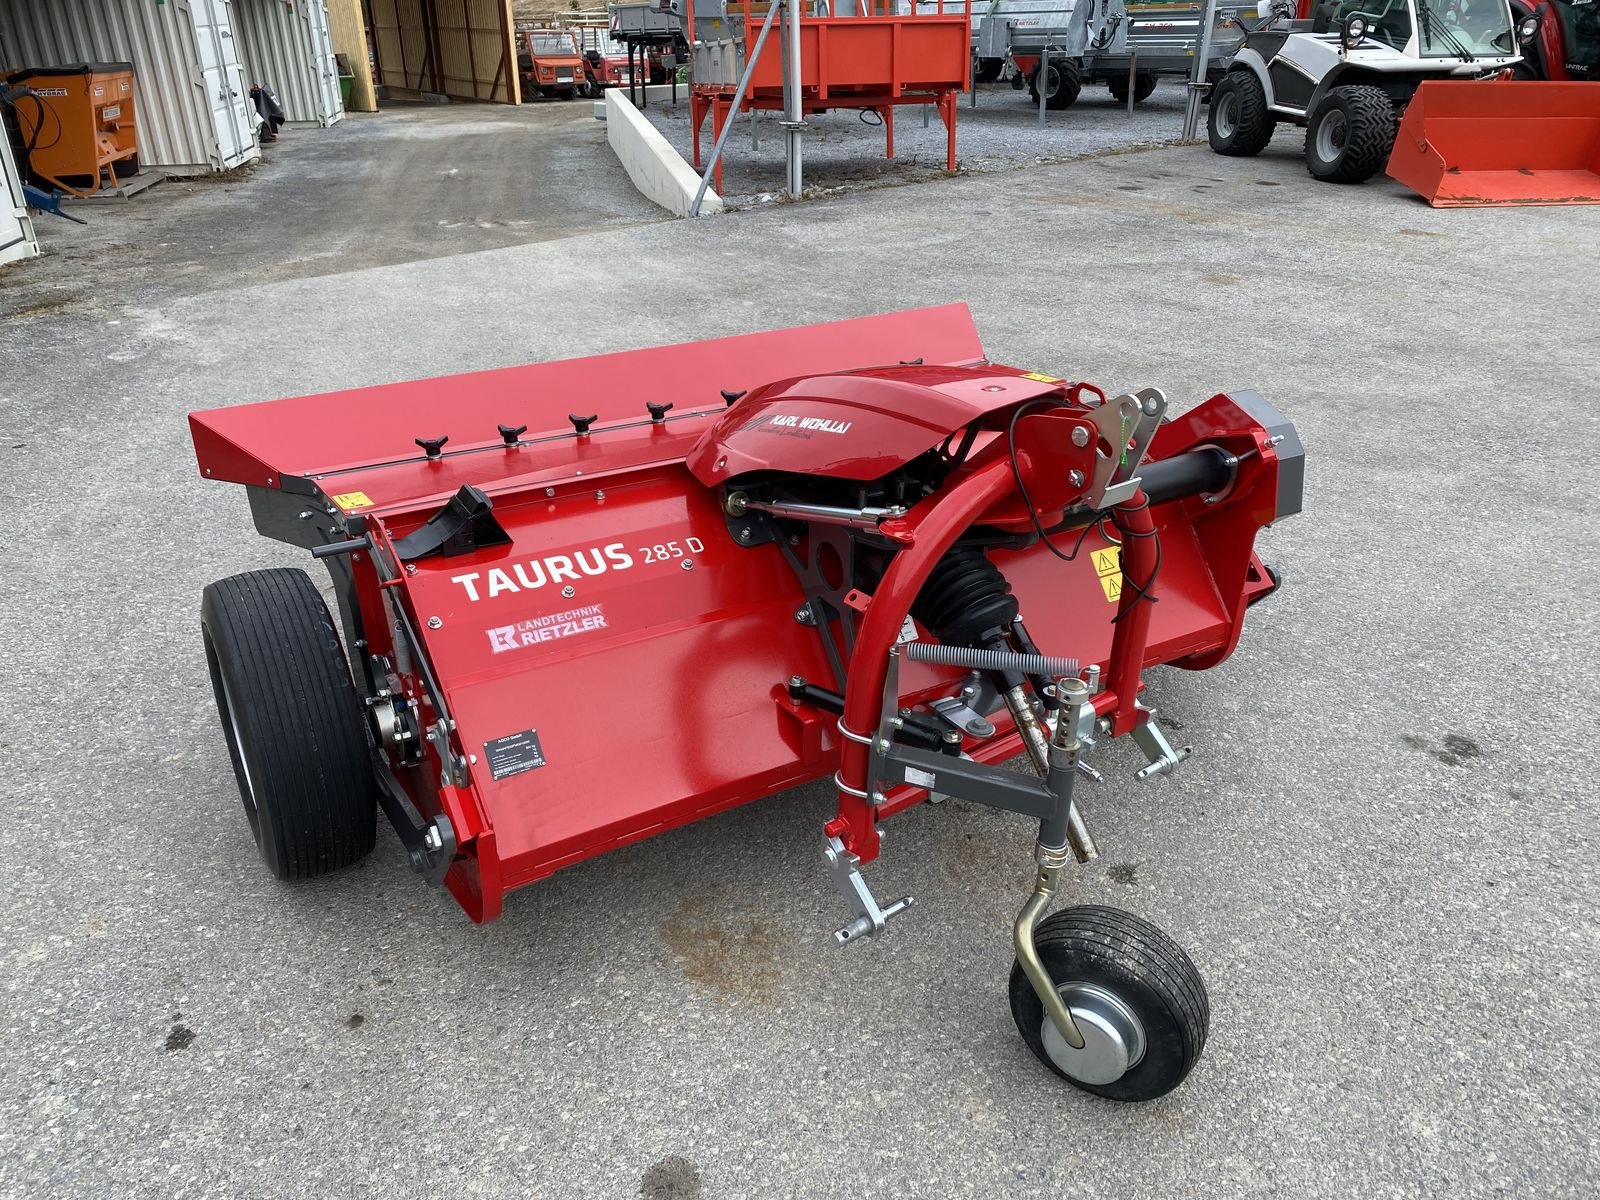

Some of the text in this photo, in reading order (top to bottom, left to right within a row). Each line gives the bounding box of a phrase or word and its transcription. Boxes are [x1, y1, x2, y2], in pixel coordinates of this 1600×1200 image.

[769, 414, 800, 427] KARL
[451, 536, 706, 602] TAURUS 285 D
[517, 604, 603, 632] LANDTECHNIK
[520, 614, 608, 646] RIETZLER
